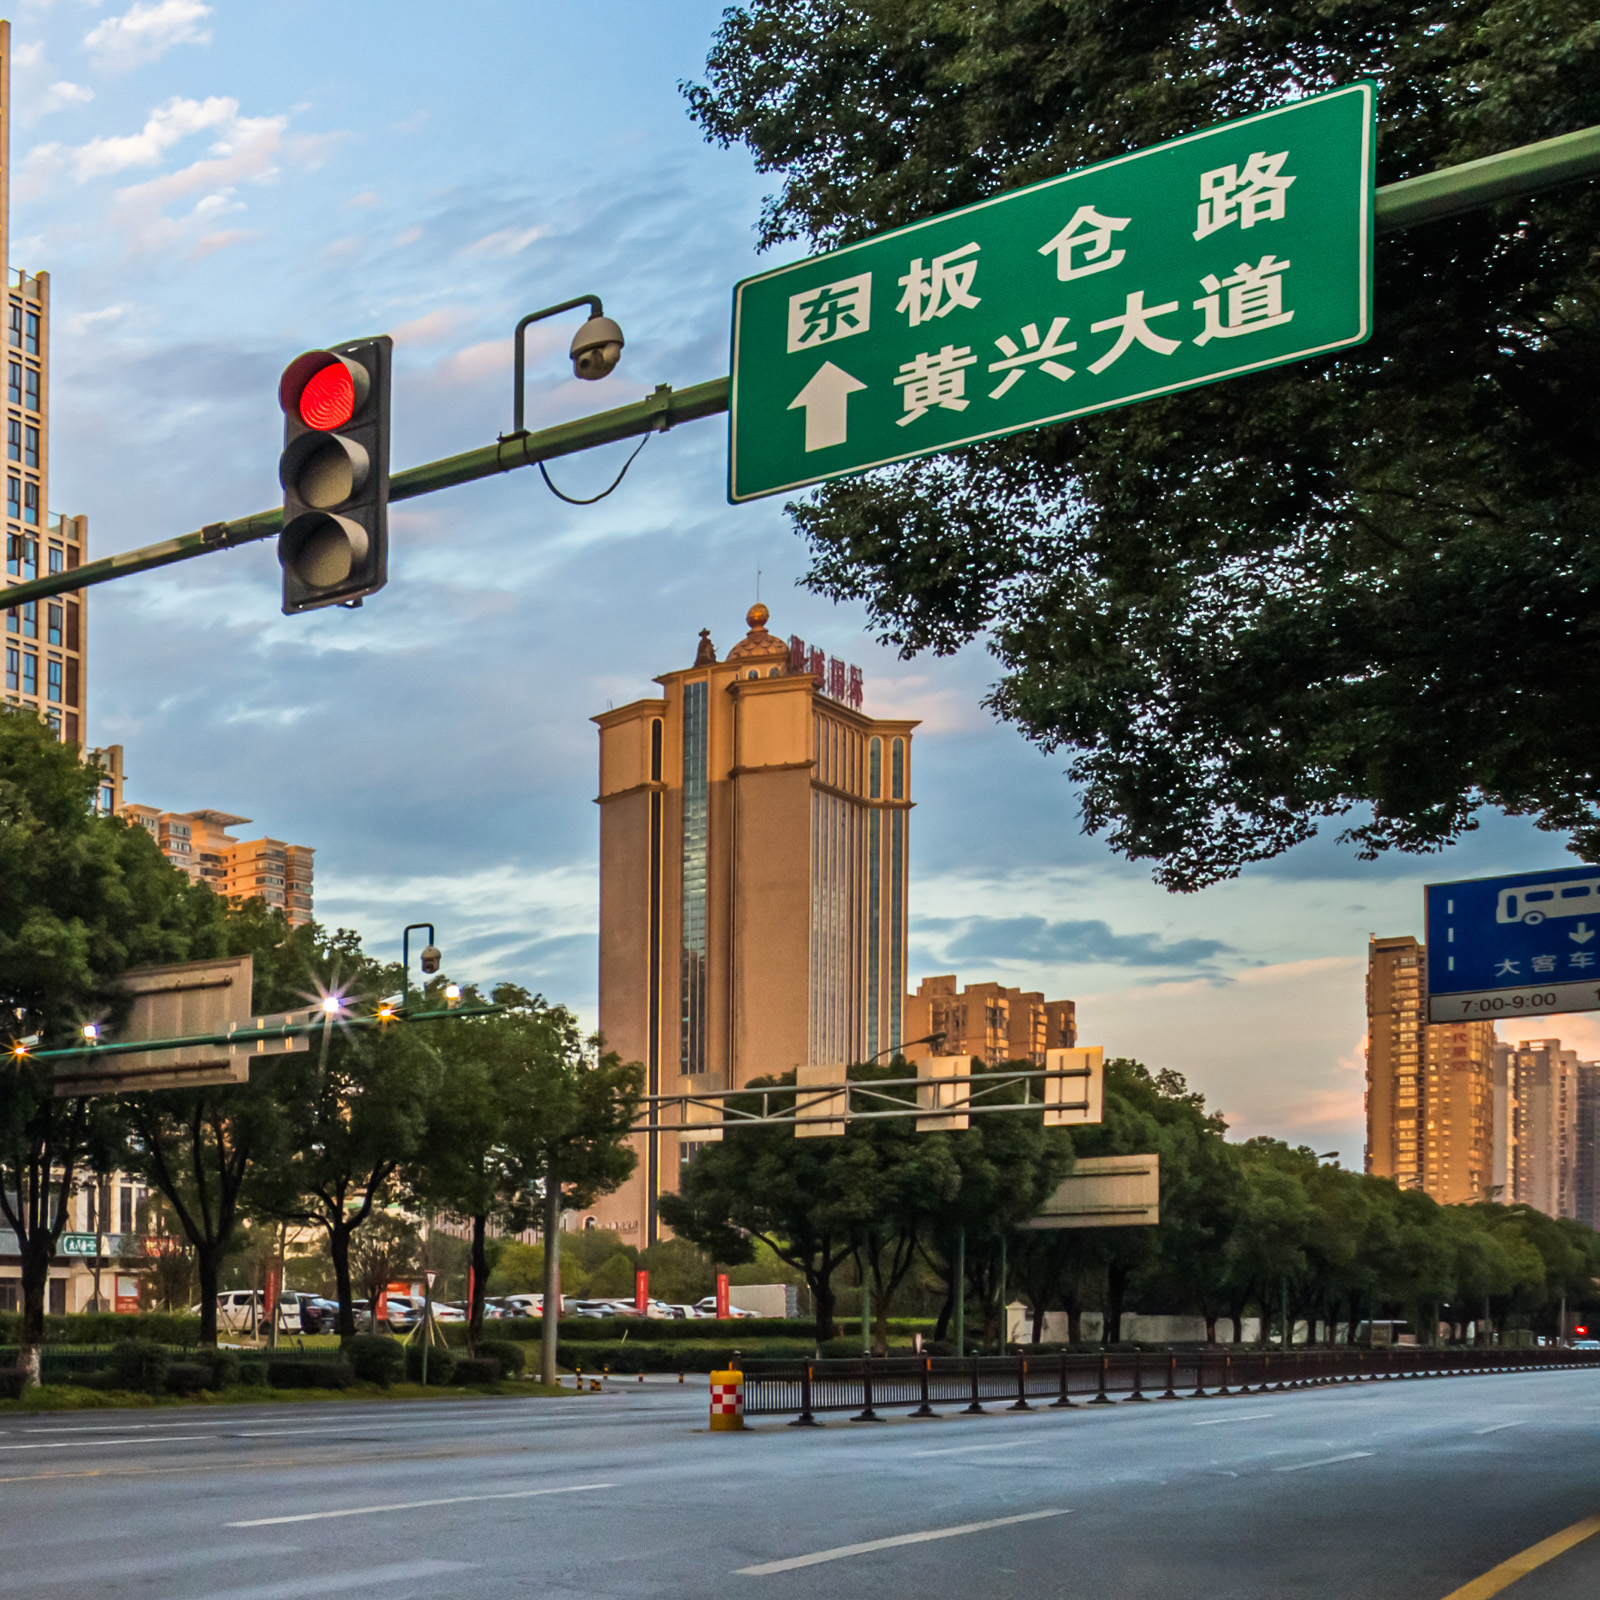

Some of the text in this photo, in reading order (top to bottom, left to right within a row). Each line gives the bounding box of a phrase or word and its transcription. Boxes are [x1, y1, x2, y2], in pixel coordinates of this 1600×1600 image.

[795, 151, 1297, 346] 东 板仓路
[894, 255, 1295, 428] 黄兴大道
[1460, 992, 1557, 1014] 7:00-9:00
[1494, 952, 1596, 977] 大客车
